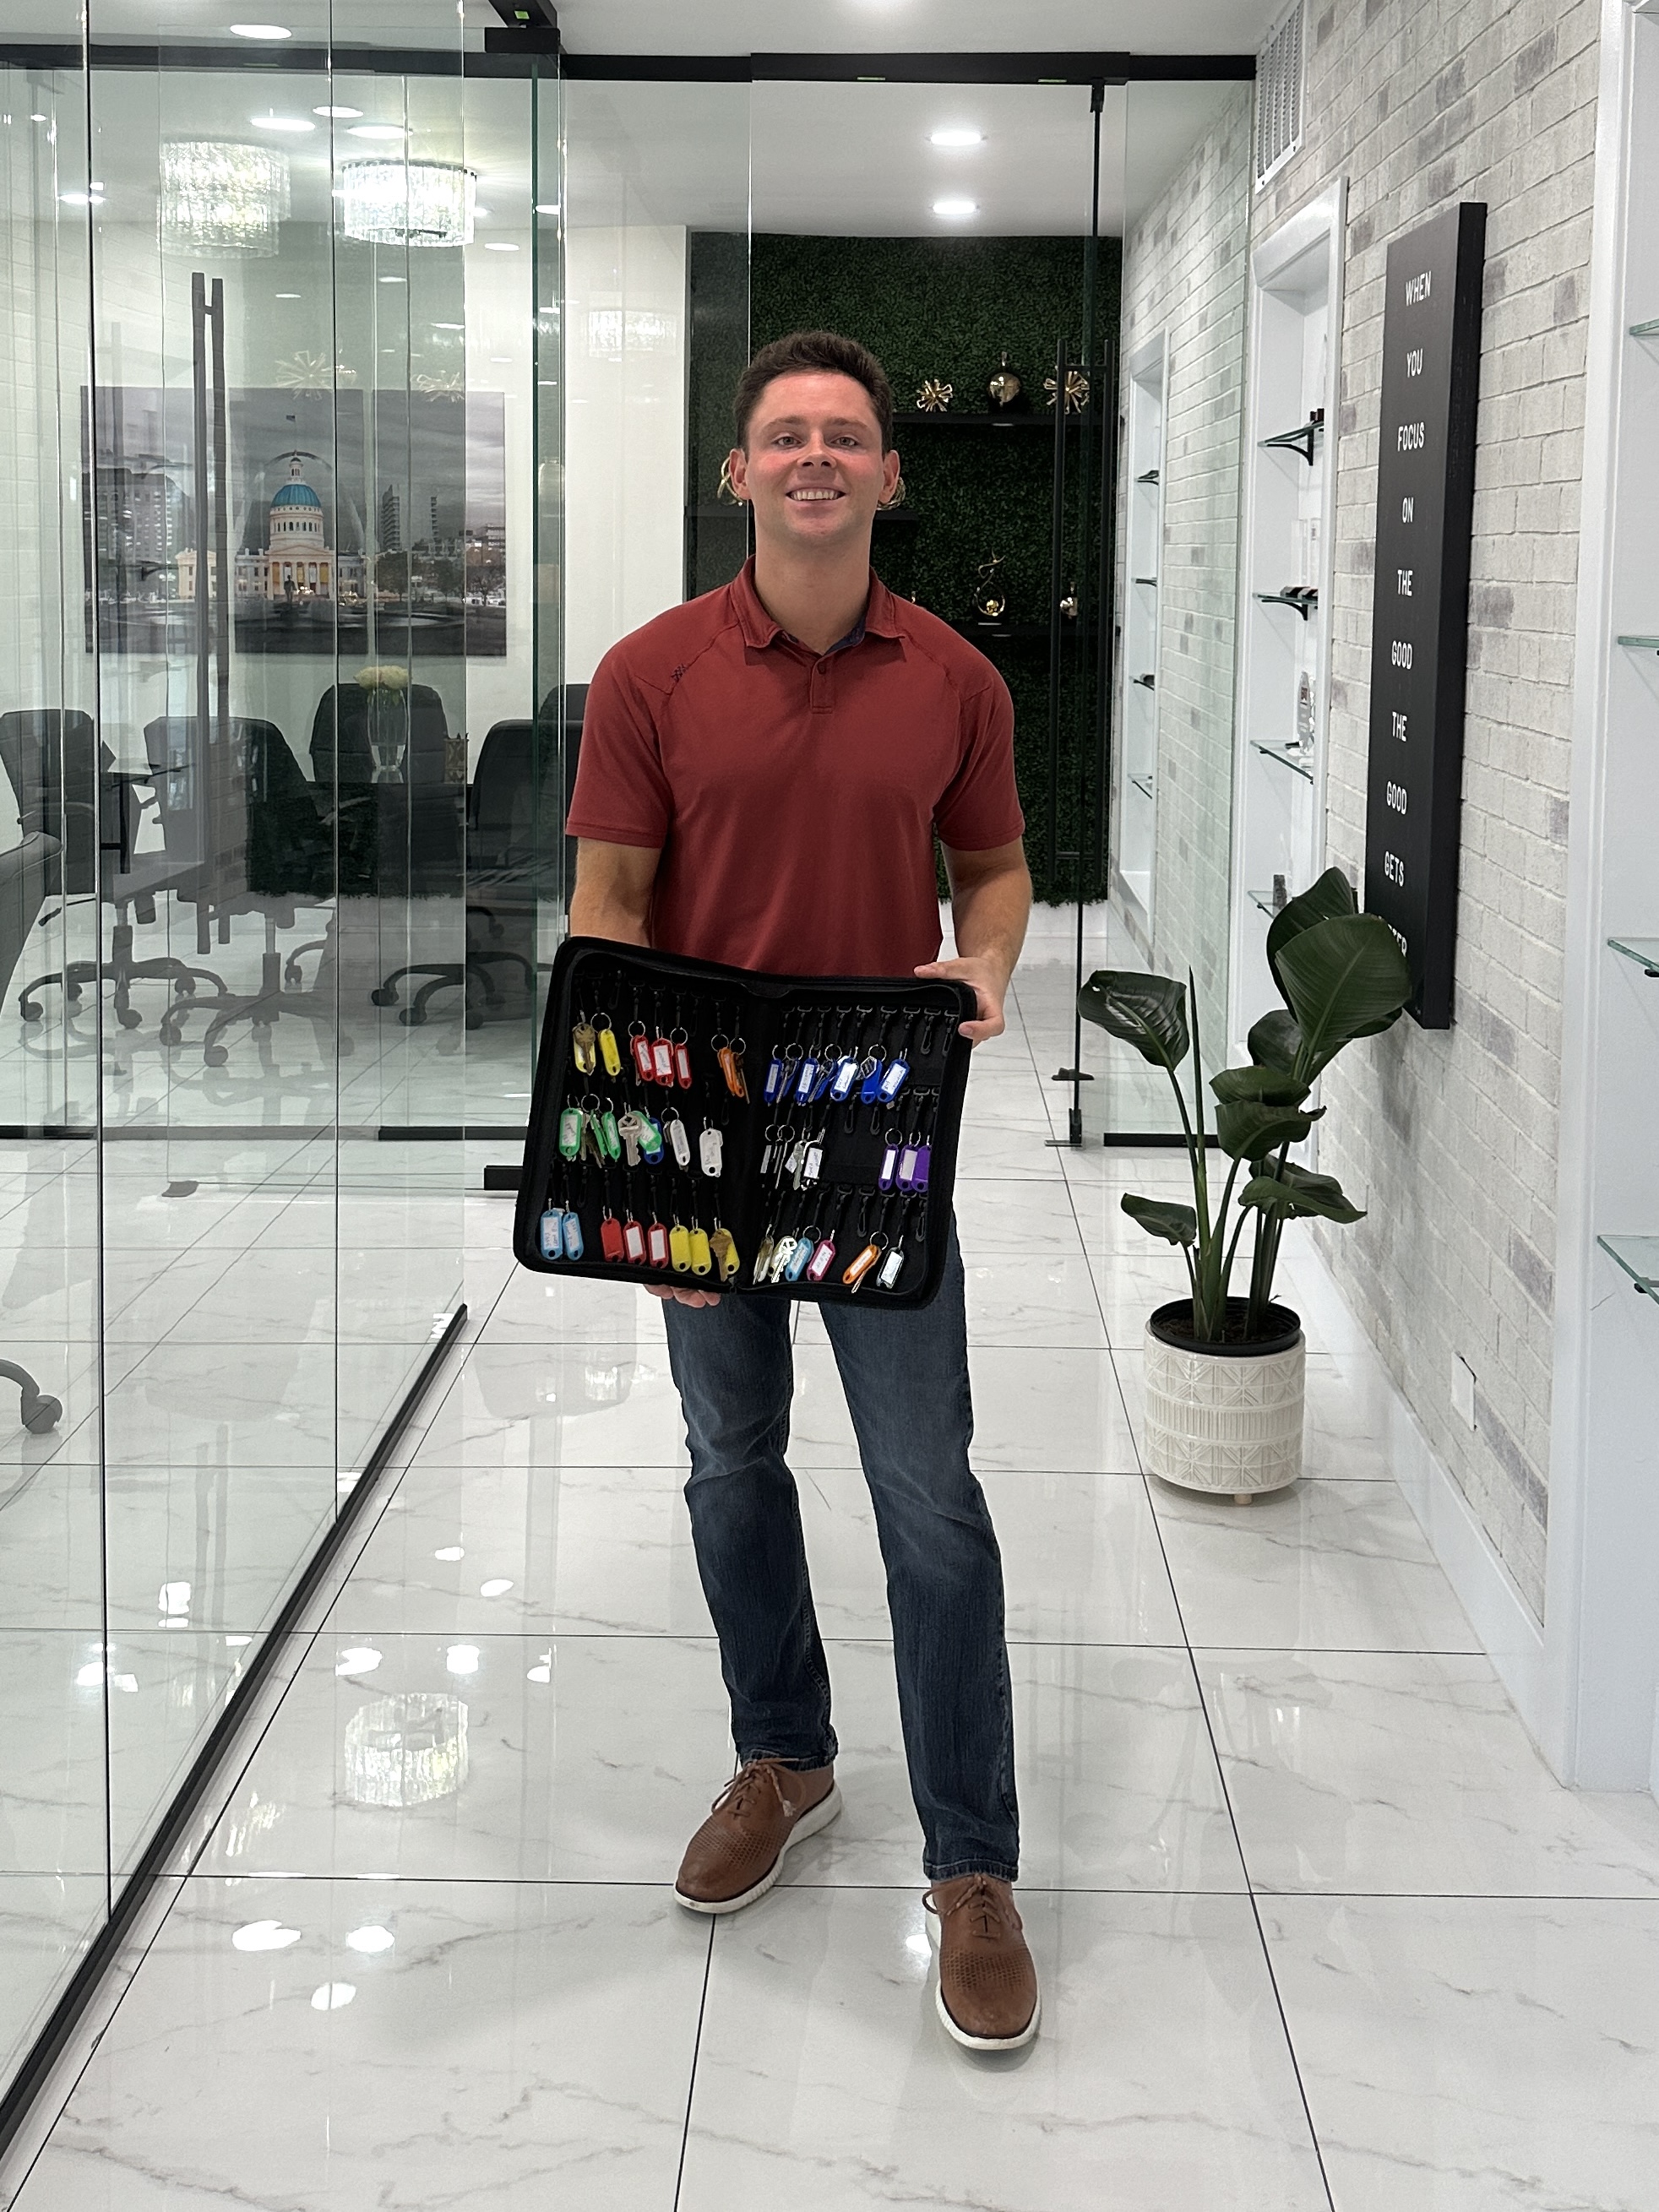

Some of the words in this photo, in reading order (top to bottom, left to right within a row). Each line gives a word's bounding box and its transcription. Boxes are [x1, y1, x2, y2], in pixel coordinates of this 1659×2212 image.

[1406, 270, 1432, 307] WHEN
[1406, 348, 1423, 378] YOU
[1397, 421, 1425, 452] FOCUS
[1402, 497, 1414, 524] ON
[1397, 569, 1413, 596] THE
[1391, 640, 1413, 670] GOOD
[1392, 711, 1407, 742] THE
[1386, 780, 1407, 815] GOOD
[1384, 851, 1404, 887] GETS
